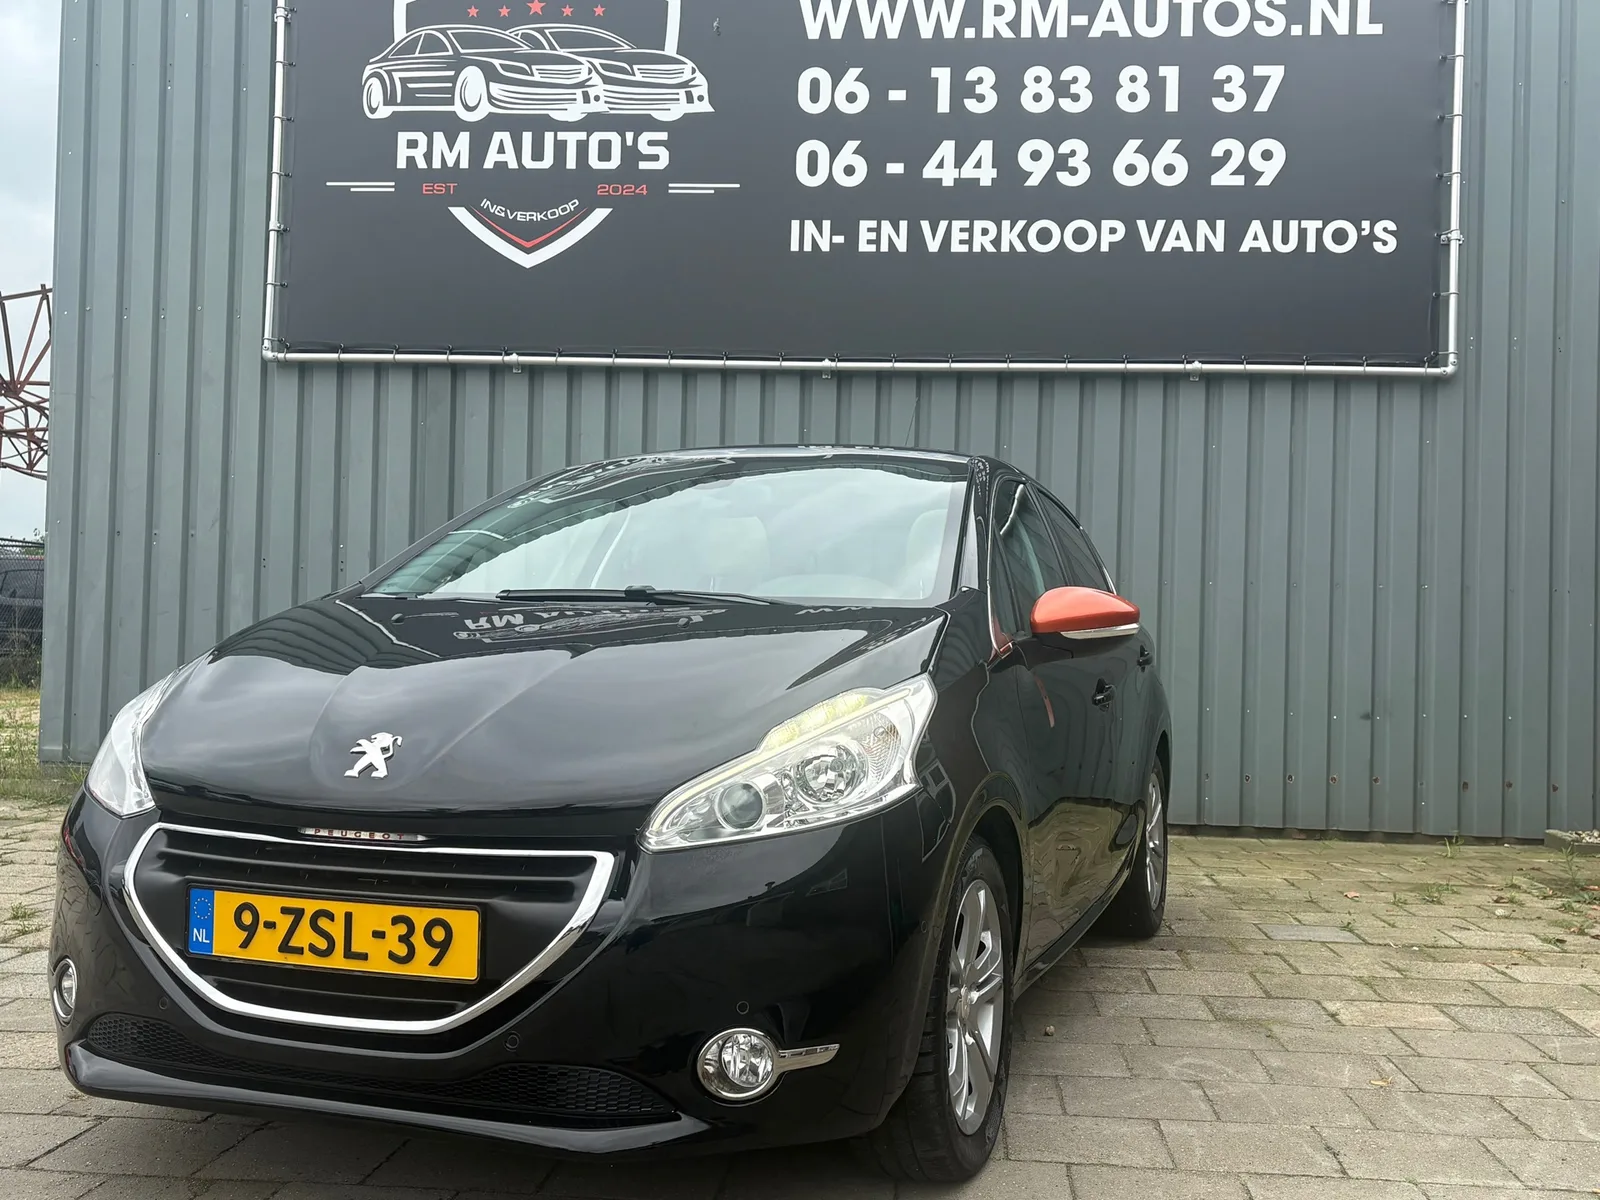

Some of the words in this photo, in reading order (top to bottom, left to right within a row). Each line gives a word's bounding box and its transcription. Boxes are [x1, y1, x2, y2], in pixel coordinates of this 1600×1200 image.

[799, 0, 1384, 40] WWW.RM-AUTOS.NL
[797, 66, 870, 115] 06
[887, 89, 907, 101] -
[930, 65, 998, 114] 13
[1020, 65, 1093, 114] 83
[1115, 64, 1180, 114] 81
[1211, 64, 1285, 113] 37
[396, 131, 470, 170] RM
[482, 131, 670, 170] AUTO'S
[795, 139, 868, 188] 06
[885, 162, 905, 174] -
[922, 139, 998, 187] 44
[1017, 138, 1092, 187] 93
[1112, 138, 1189, 187] 66
[1210, 137, 1287, 187] 29
[422, 183, 458, 195] EST
[597, 184, 648, 196] 2024
[790, 219, 845, 253] IN-
[858, 219, 908, 253] EN
[919, 219, 1126, 253] VERKOOP
[1135, 219, 1226, 253] VAN
[1238, 219, 1398, 254] AUTO’S
[313, 827, 404, 840] PEUGEOT
[192, 927, 211, 944] NL
[233, 901, 454, 967] 9-ZSL-39
